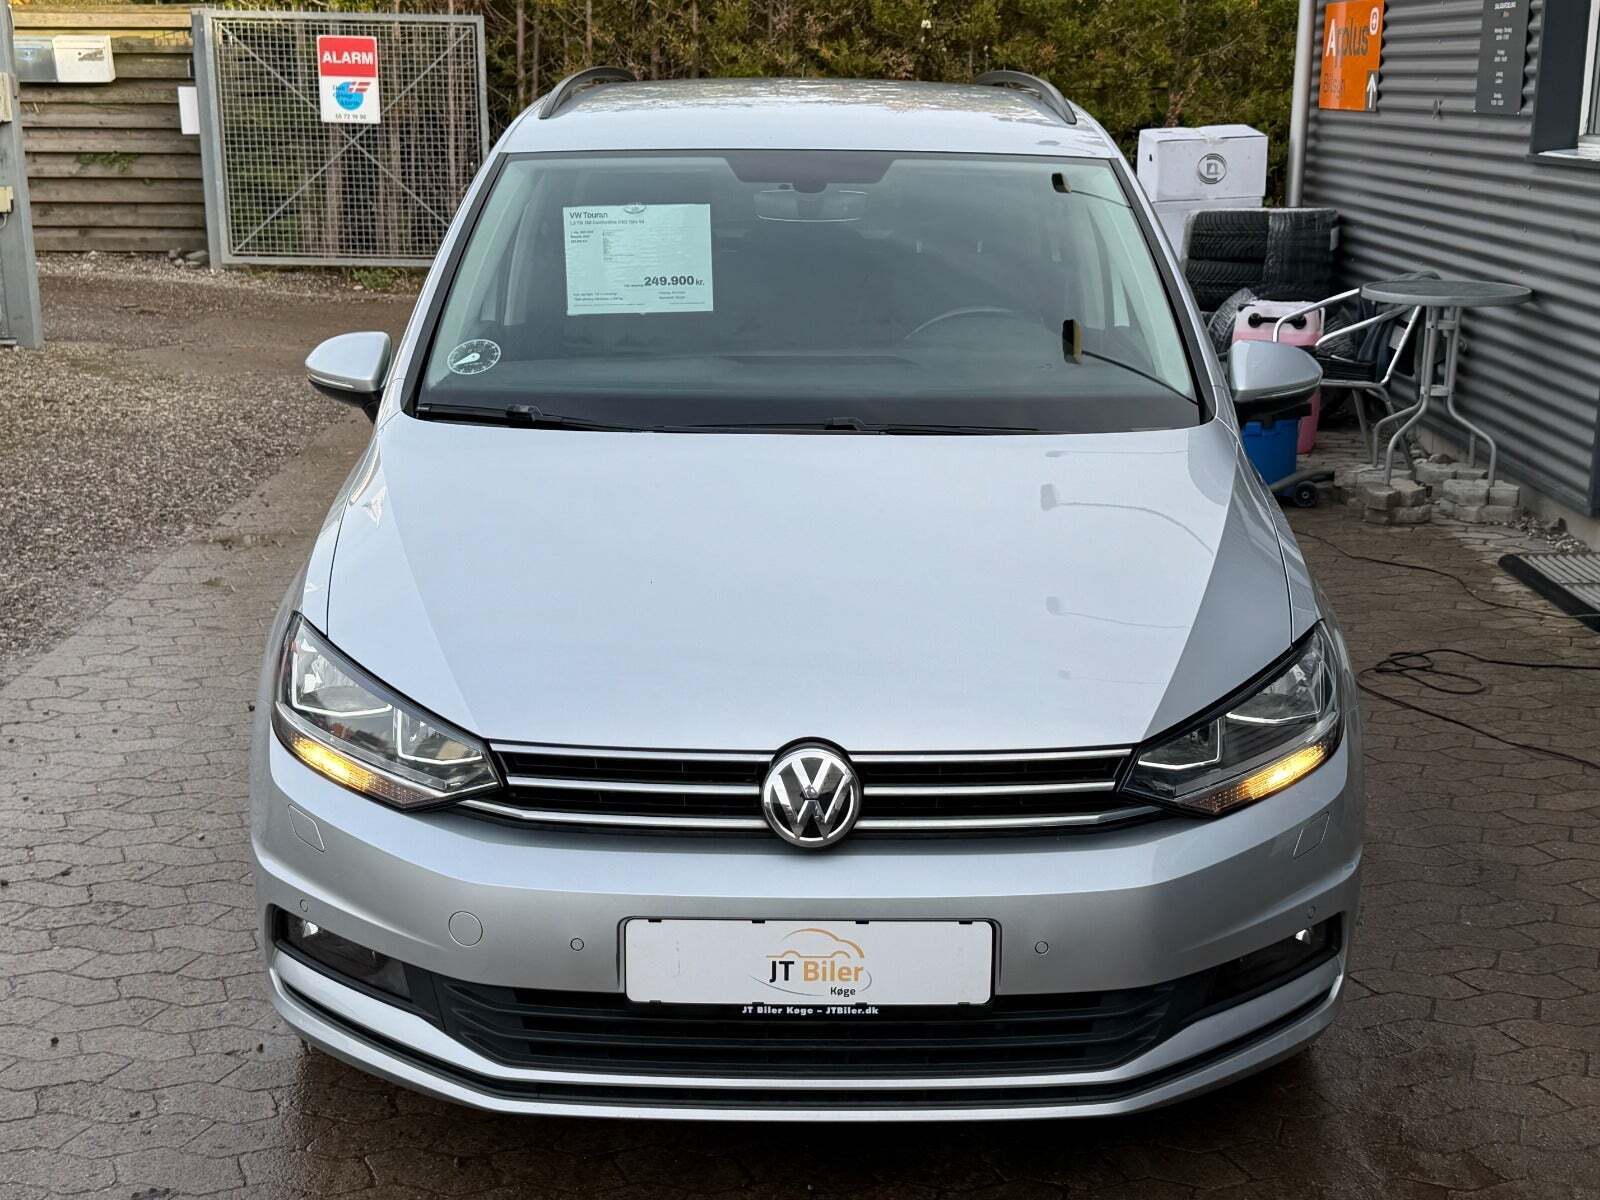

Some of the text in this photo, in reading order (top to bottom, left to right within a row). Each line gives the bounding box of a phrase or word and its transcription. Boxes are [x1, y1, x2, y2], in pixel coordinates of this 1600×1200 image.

[322, 51, 374, 65] ALARM
[570, 211, 608, 219] VW Touran
[644, 275, 695, 286] 249.900
[695, 278, 705, 286] kr.
[769, 960, 864, 983] JT Biler
[830, 986, 856, 998] Køge
[742, 1005, 754, 1015] JT
[757, 1005, 783, 1015] Biler
[825, 1005, 879, 1015] JTBiler.dk
